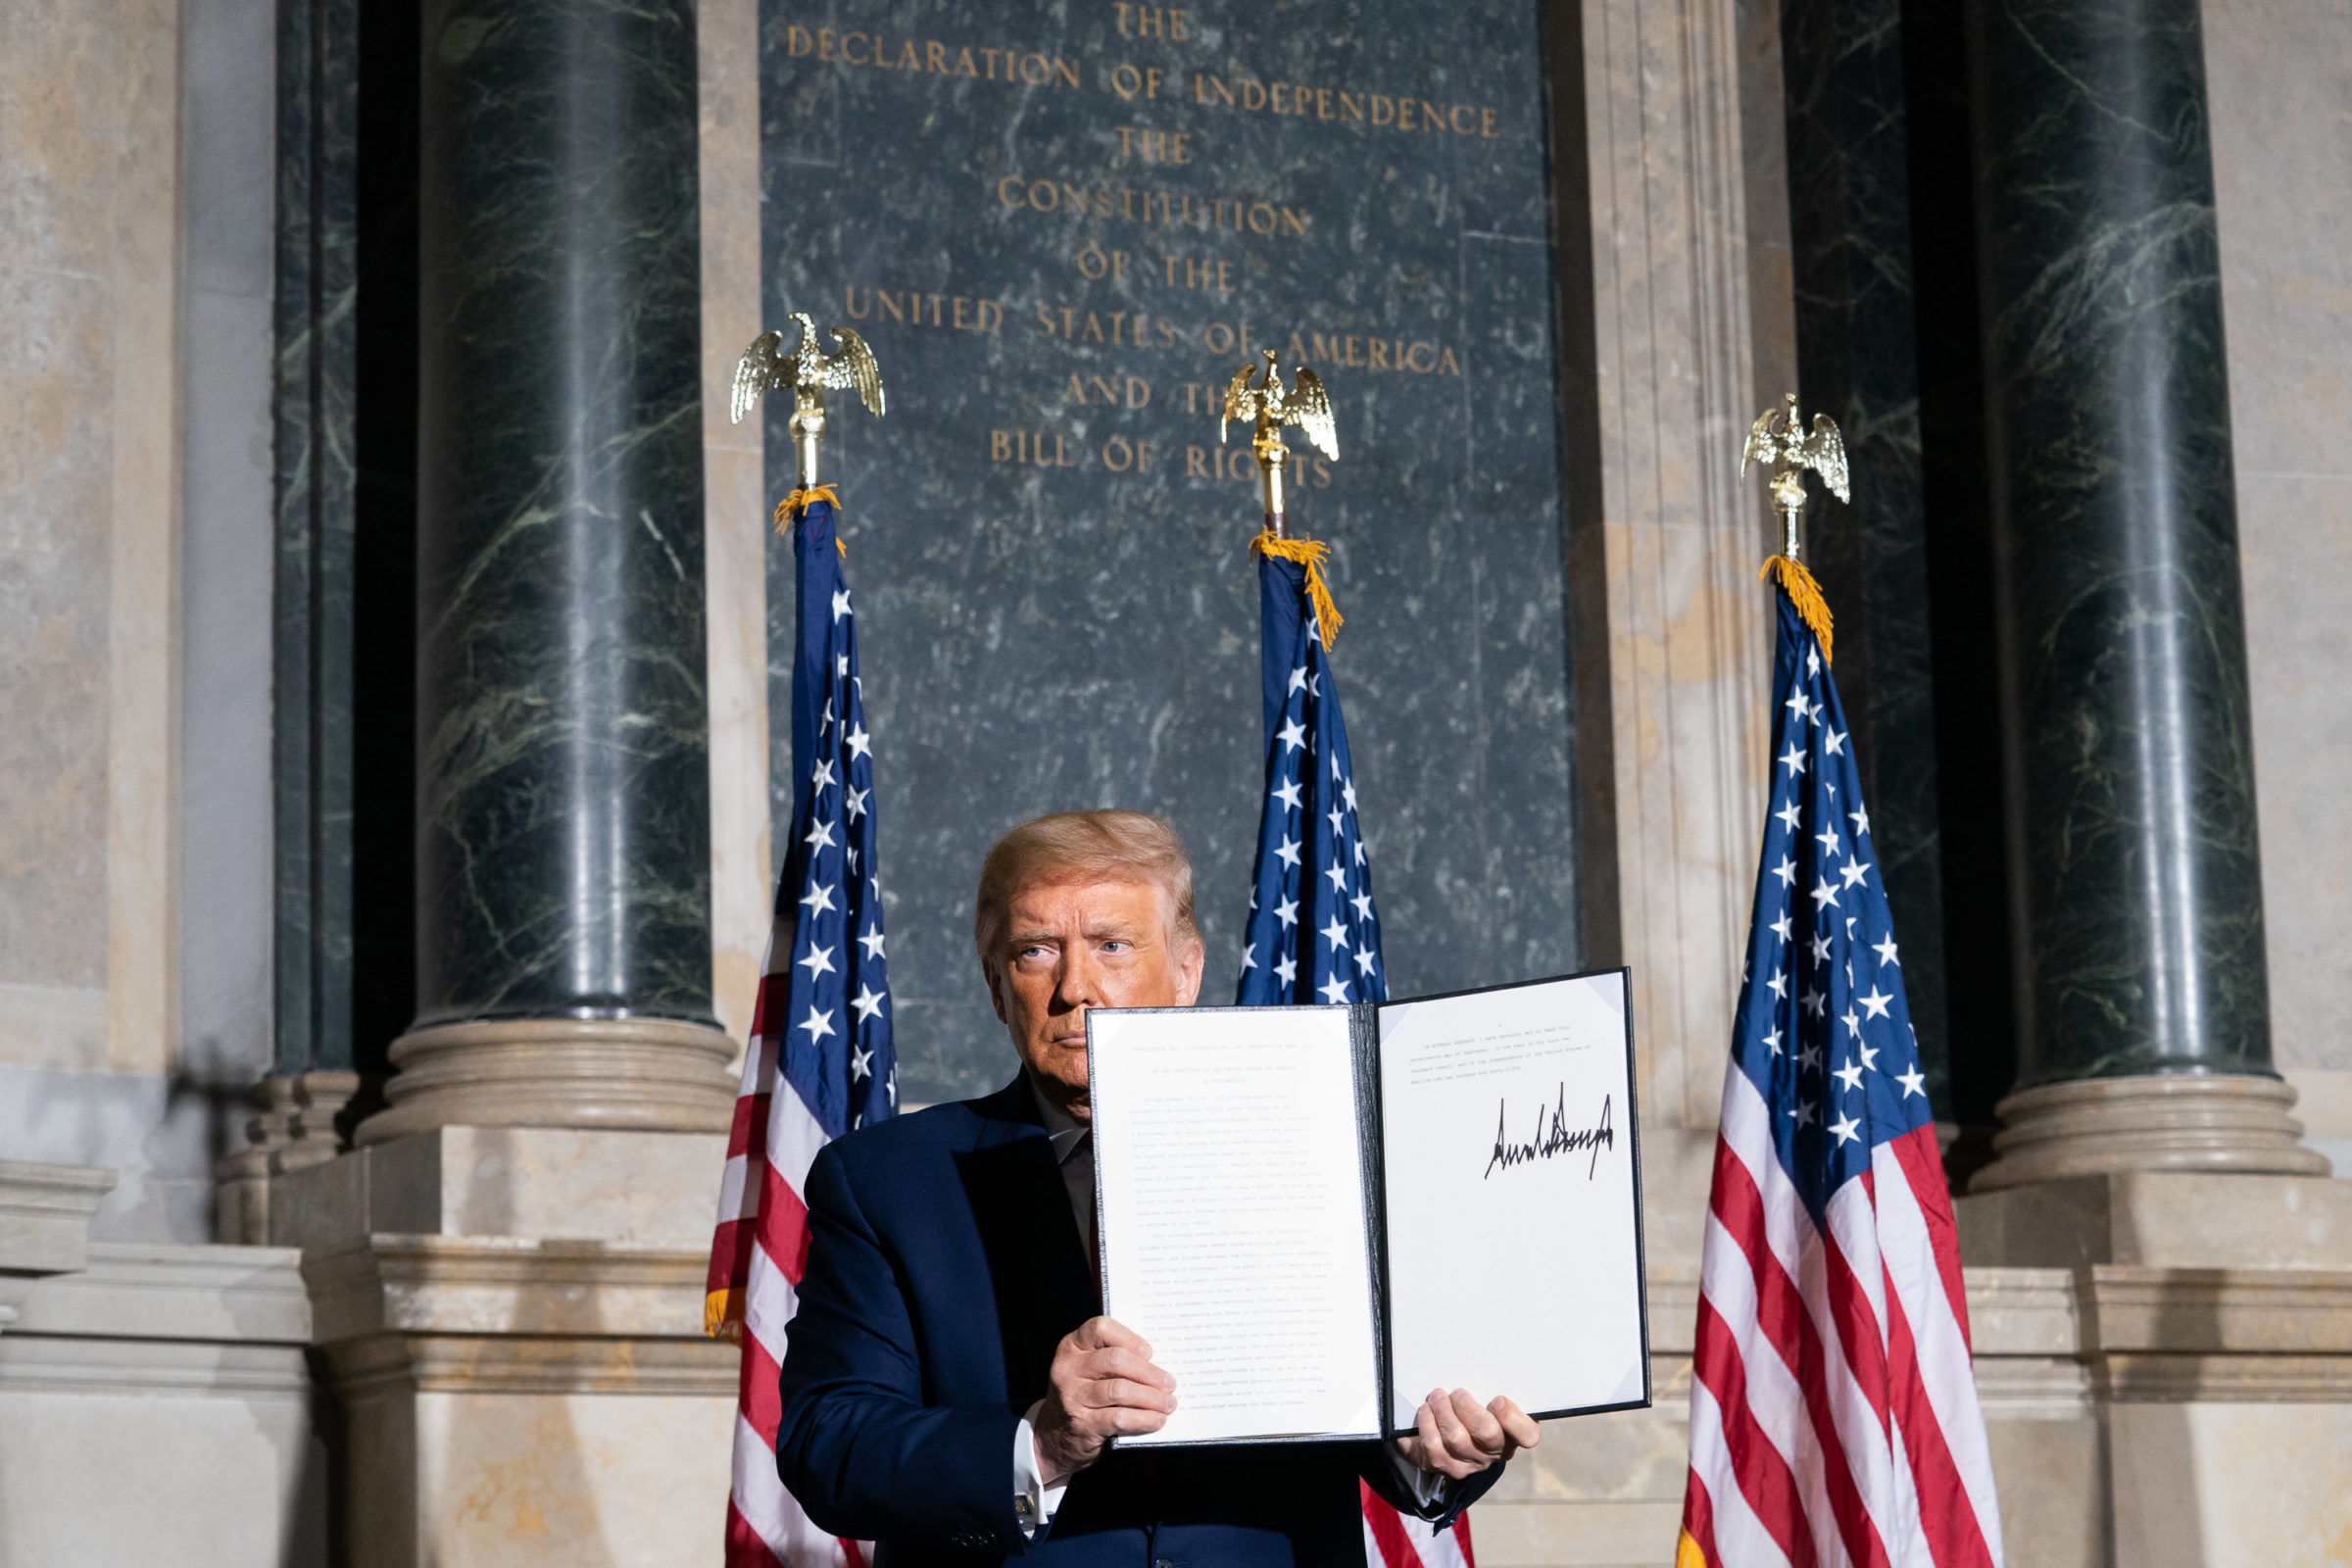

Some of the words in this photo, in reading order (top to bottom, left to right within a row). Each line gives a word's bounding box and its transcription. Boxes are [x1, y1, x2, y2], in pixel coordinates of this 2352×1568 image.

[1111, 2, 1189, 41] THE
[787, 24, 1080, 89] DECLARATION
[1110, 64, 1163, 99] OF
[1195, 74, 1500, 138] INDEPENDENCE
[1114, 125, 1193, 165] THE
[998, 174, 1307, 236] CONSTITUTION
[1078, 247, 1129, 281] OF
[1160, 255, 1237, 293] THE
[846, 285, 1003, 332] UNITED
[1035, 304, 1176, 349] STATES
[1203, 321, 1255, 357] OF
[1286, 331, 1460, 376] AMERICA
[1064, 372, 1151, 410] AND
[1181, 382, 1226, 416] TH
[991, 429, 1076, 467] BILL
[1102, 435, 1152, 473] OF
[1187, 446, 1332, 489] RIGTS
